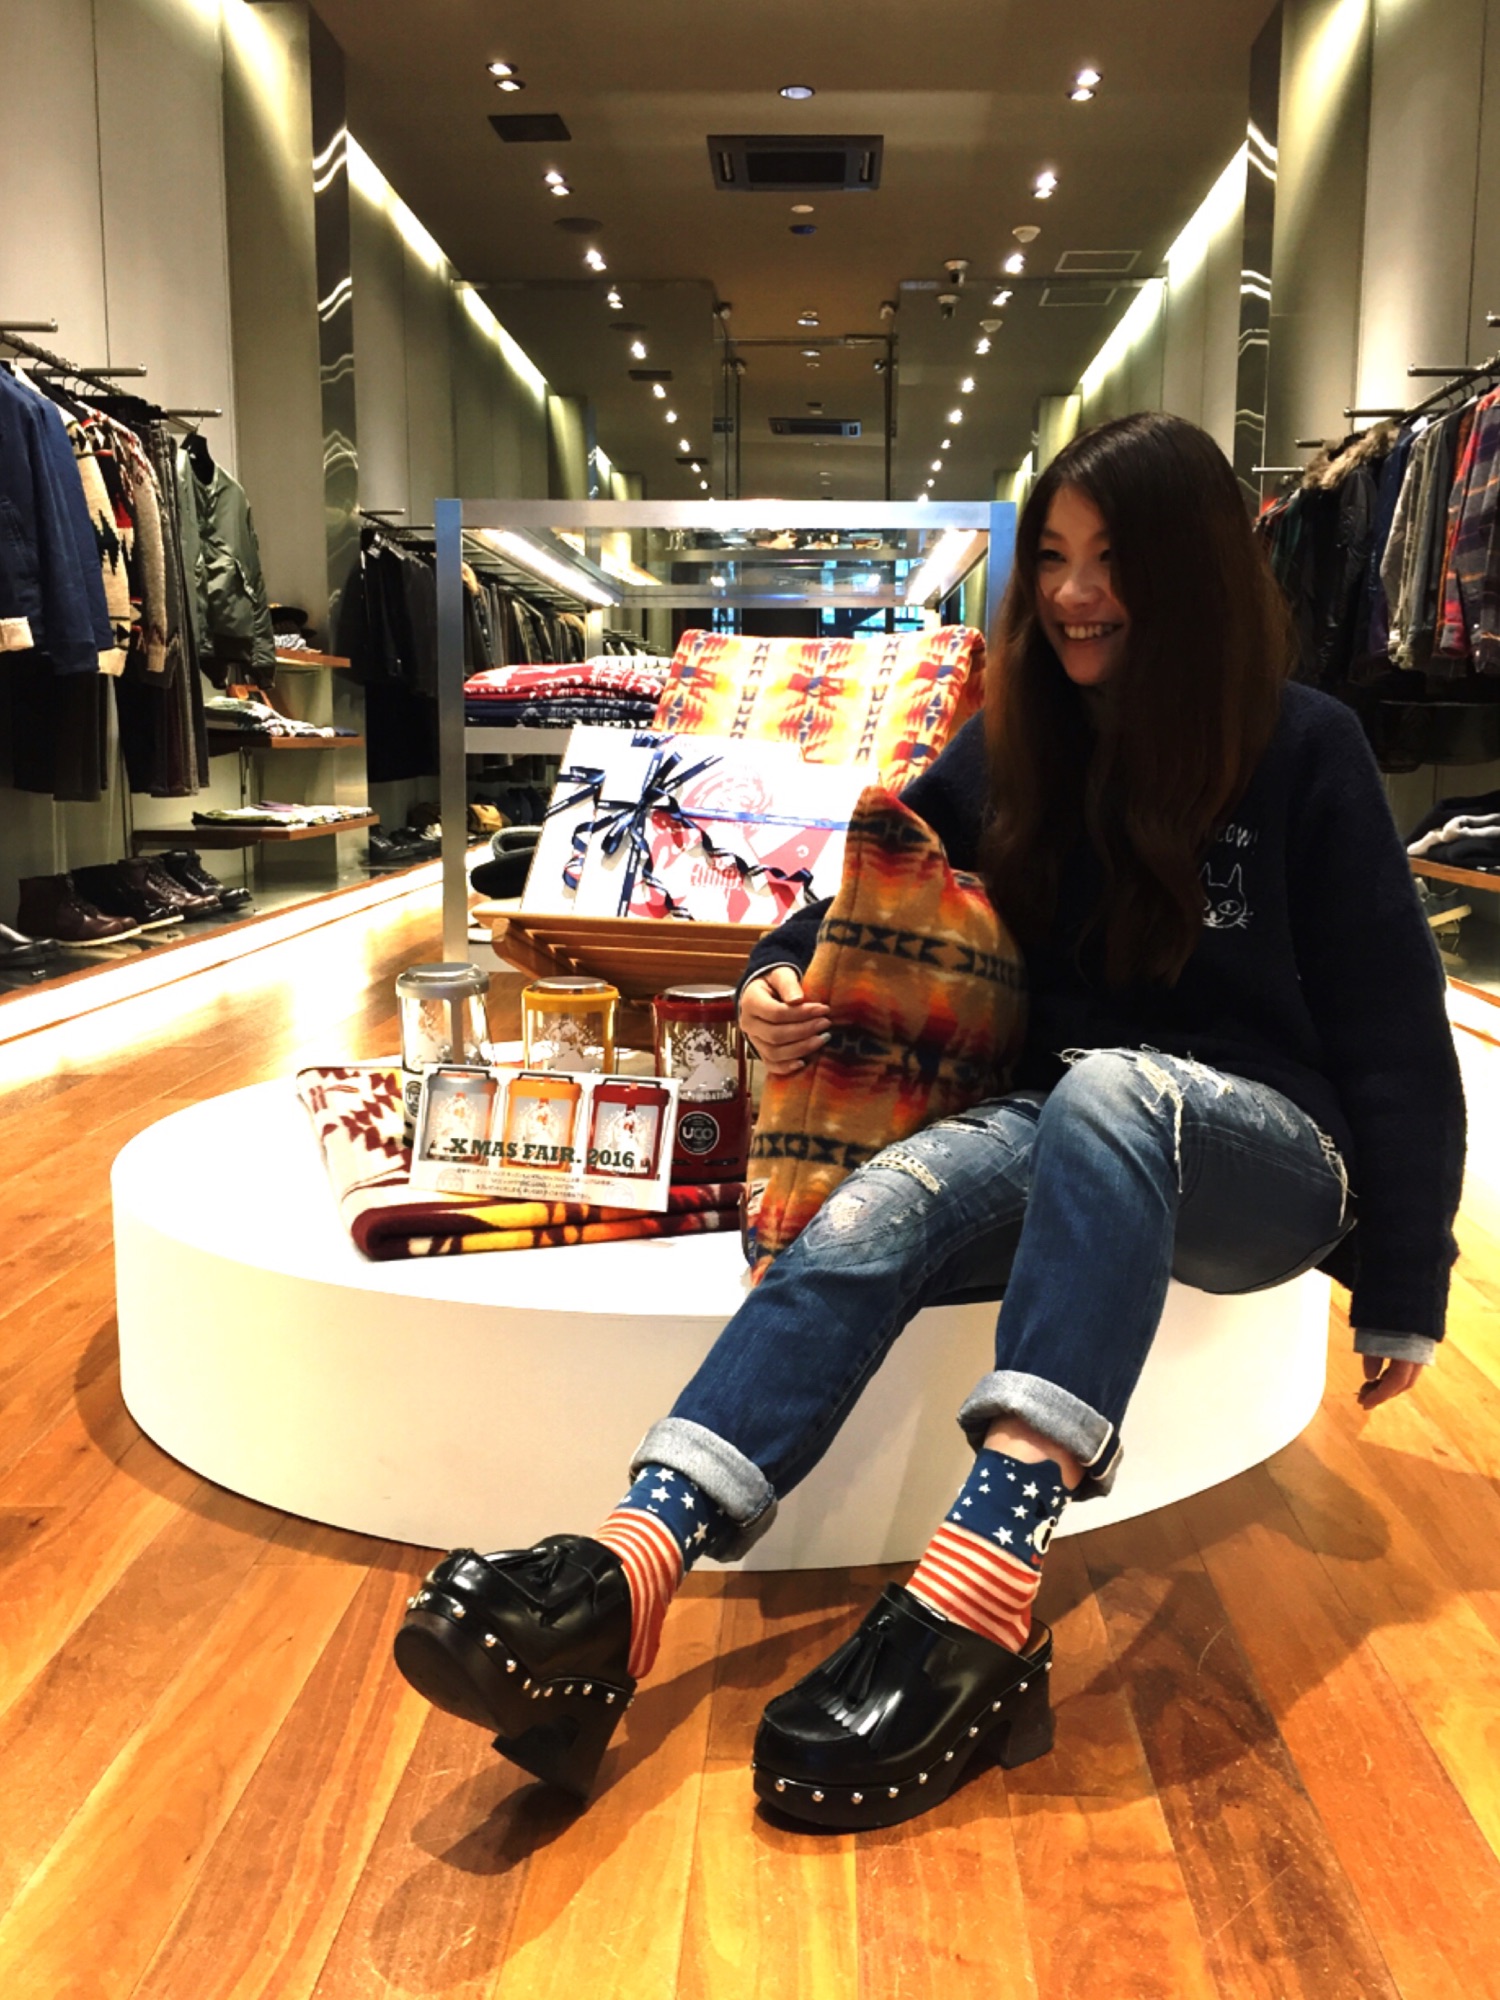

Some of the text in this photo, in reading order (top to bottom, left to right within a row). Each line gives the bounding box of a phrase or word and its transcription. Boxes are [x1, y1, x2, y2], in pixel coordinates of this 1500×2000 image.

[682, 1126, 714, 1140] UCO
[523, 1143, 582, 1164] FAIR.
[586, 1149, 635, 1168] 2016
